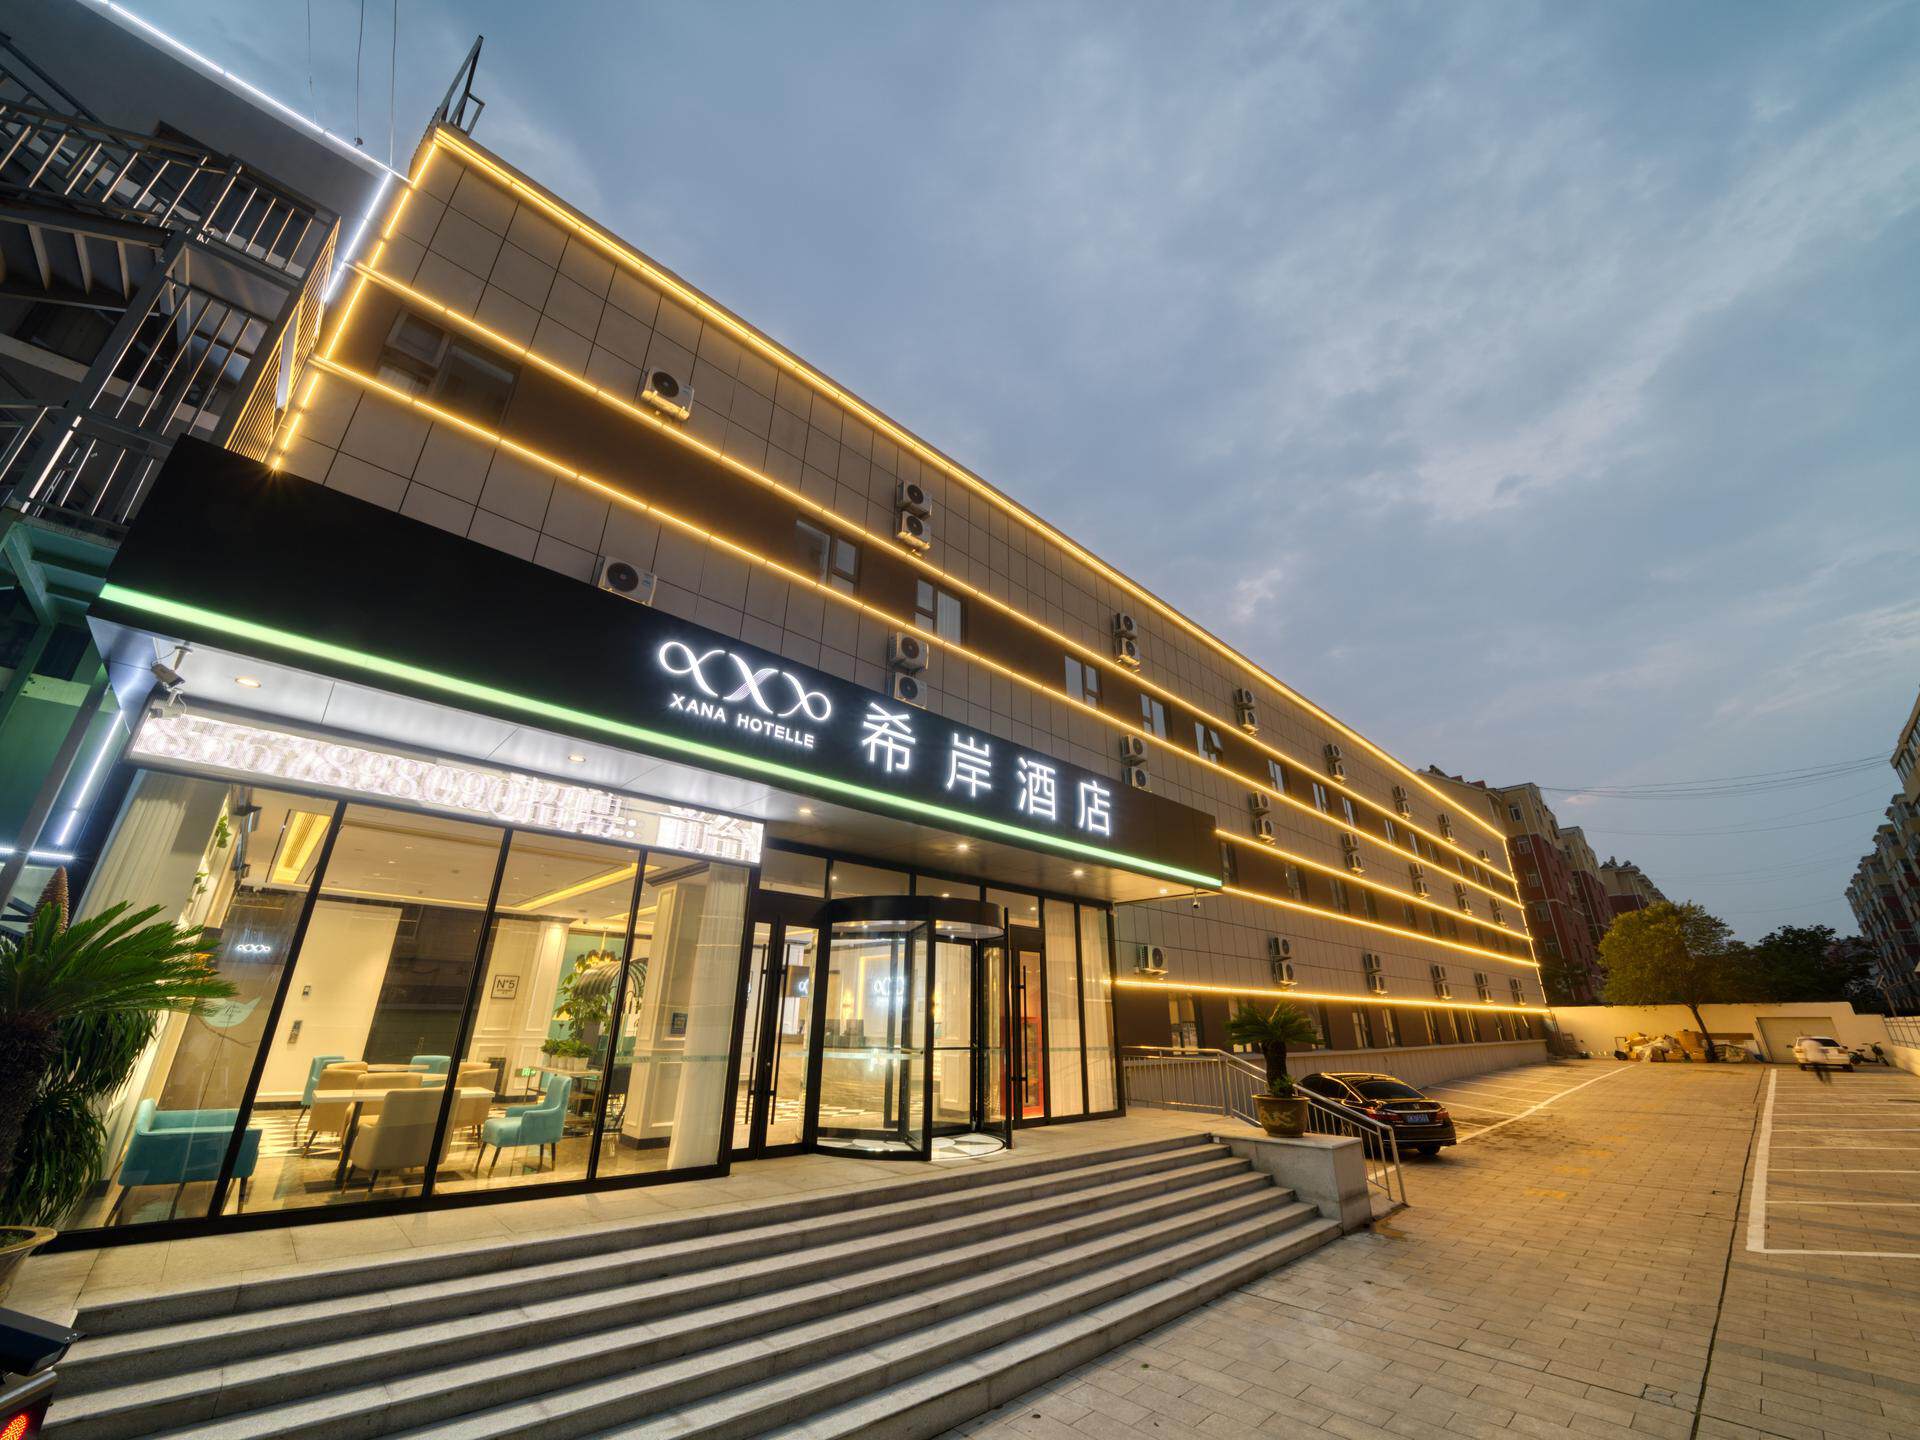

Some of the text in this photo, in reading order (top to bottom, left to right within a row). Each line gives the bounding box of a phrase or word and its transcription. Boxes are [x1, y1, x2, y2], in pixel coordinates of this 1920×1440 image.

[669, 693, 815, 749] XANA HOTELLE
[861, 702, 1111, 836] 希岸酒店
